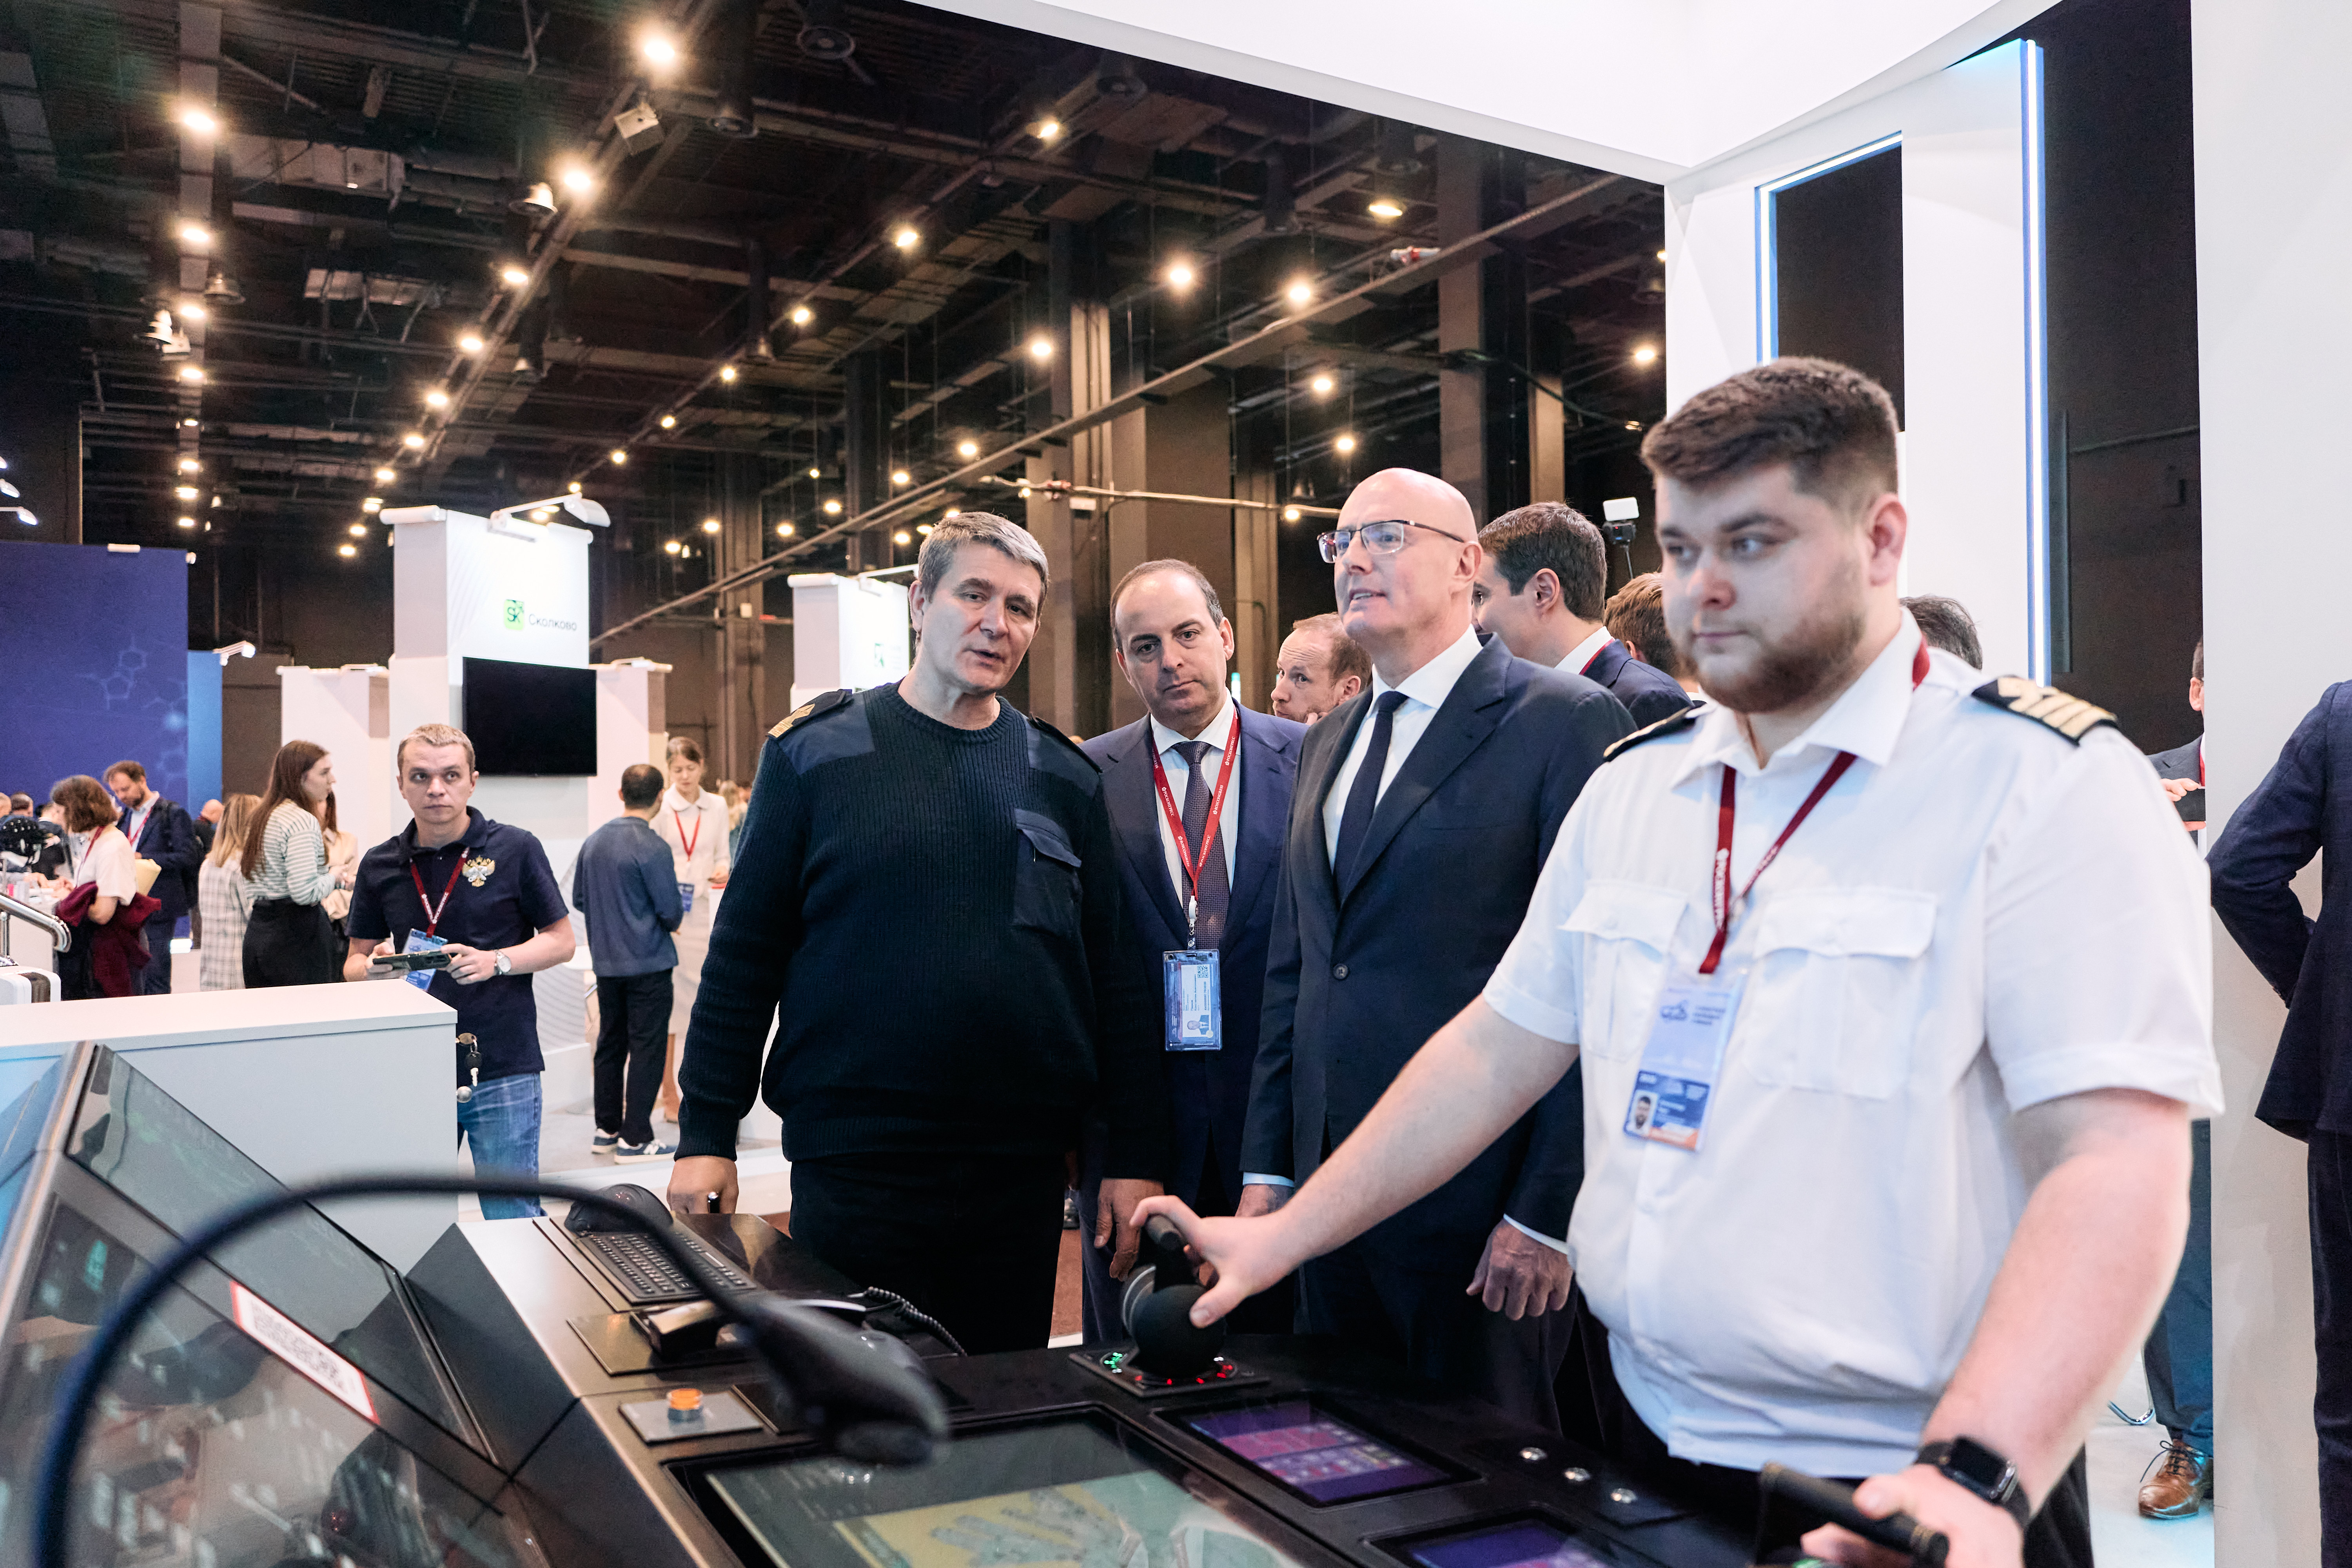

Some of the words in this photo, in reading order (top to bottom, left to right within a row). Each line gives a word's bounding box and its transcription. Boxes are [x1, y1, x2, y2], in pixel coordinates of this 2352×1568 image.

[529, 613, 577, 631] Сколково
[1226, 736, 1236, 762] РОСКОНГРЕСС
[1163, 791, 1175, 817] РОСКОНГРЕСС
[1214, 784, 1223, 810] ROSCONGRESS
[1180, 840, 1190, 867] ROSCONGRESS
